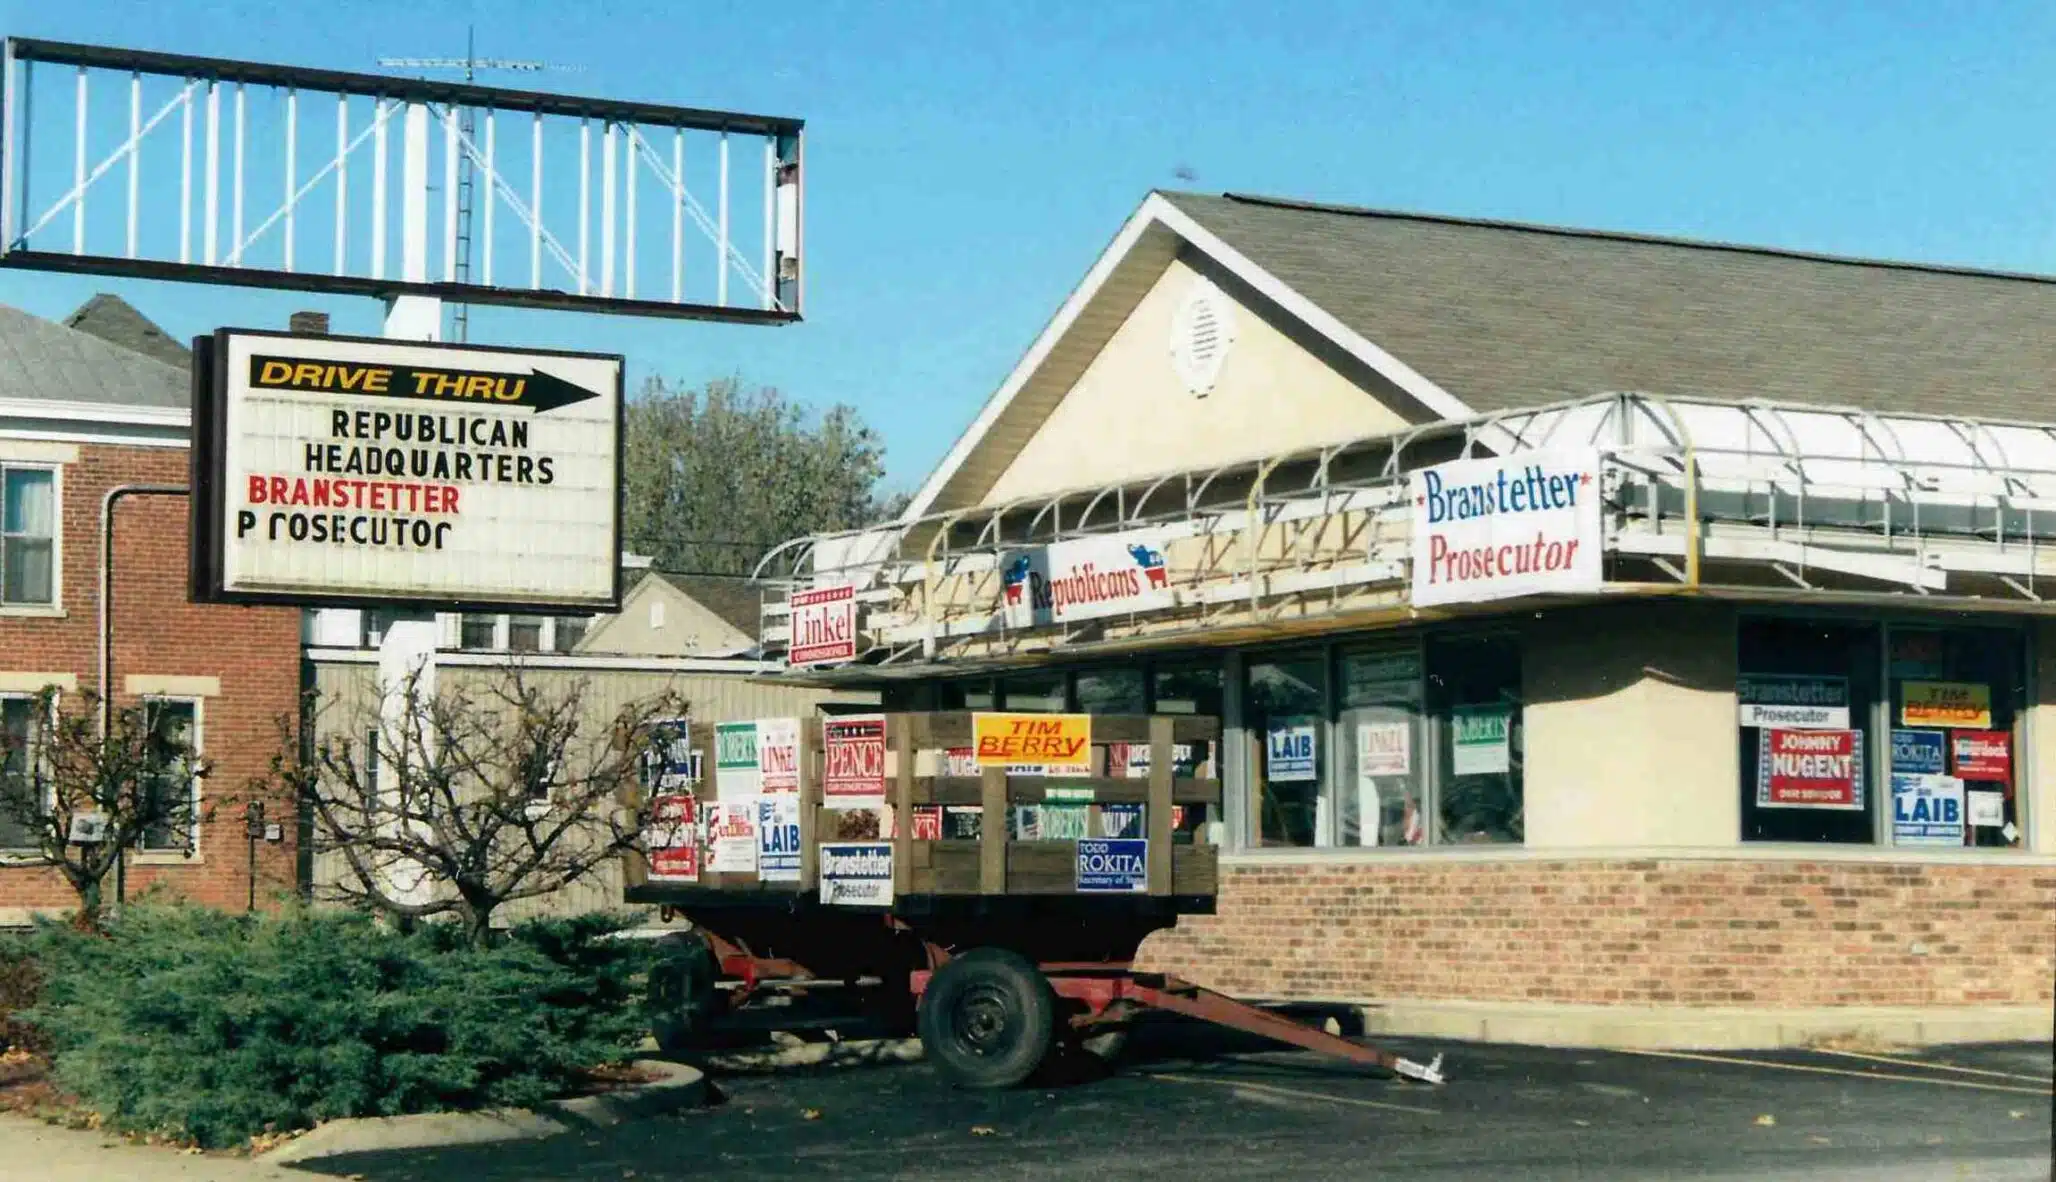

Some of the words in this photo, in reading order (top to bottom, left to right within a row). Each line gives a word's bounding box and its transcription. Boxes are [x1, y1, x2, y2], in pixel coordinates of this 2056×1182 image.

[260, 361, 394, 392] DRIVE
[411, 372, 527, 401] THRU
[333, 410, 528, 448] REPUBLICAN
[306, 444, 554, 484] HEADQUARTERS
[248, 475, 460, 515] BRANSTETTER
[1424, 465, 1579, 523] Branstetter
[1429, 531, 1579, 584] Prosecutor
[1029, 562, 1140, 615] Republicans
[793, 604, 851, 646] Linkel
[1010, 720, 1062, 735] TIM
[1753, 707, 1830, 723] Prosecutor
[826, 742, 883, 777] PENCE
[978, 736, 1086, 757] BERRY
[1272, 735, 1312, 758] LAIB
[1772, 753, 1852, 778] NUGENT
[1896, 797, 1959, 822] LAIB
[762, 825, 800, 852] LAIB
[1079, 855, 1144, 873] ROKITA
